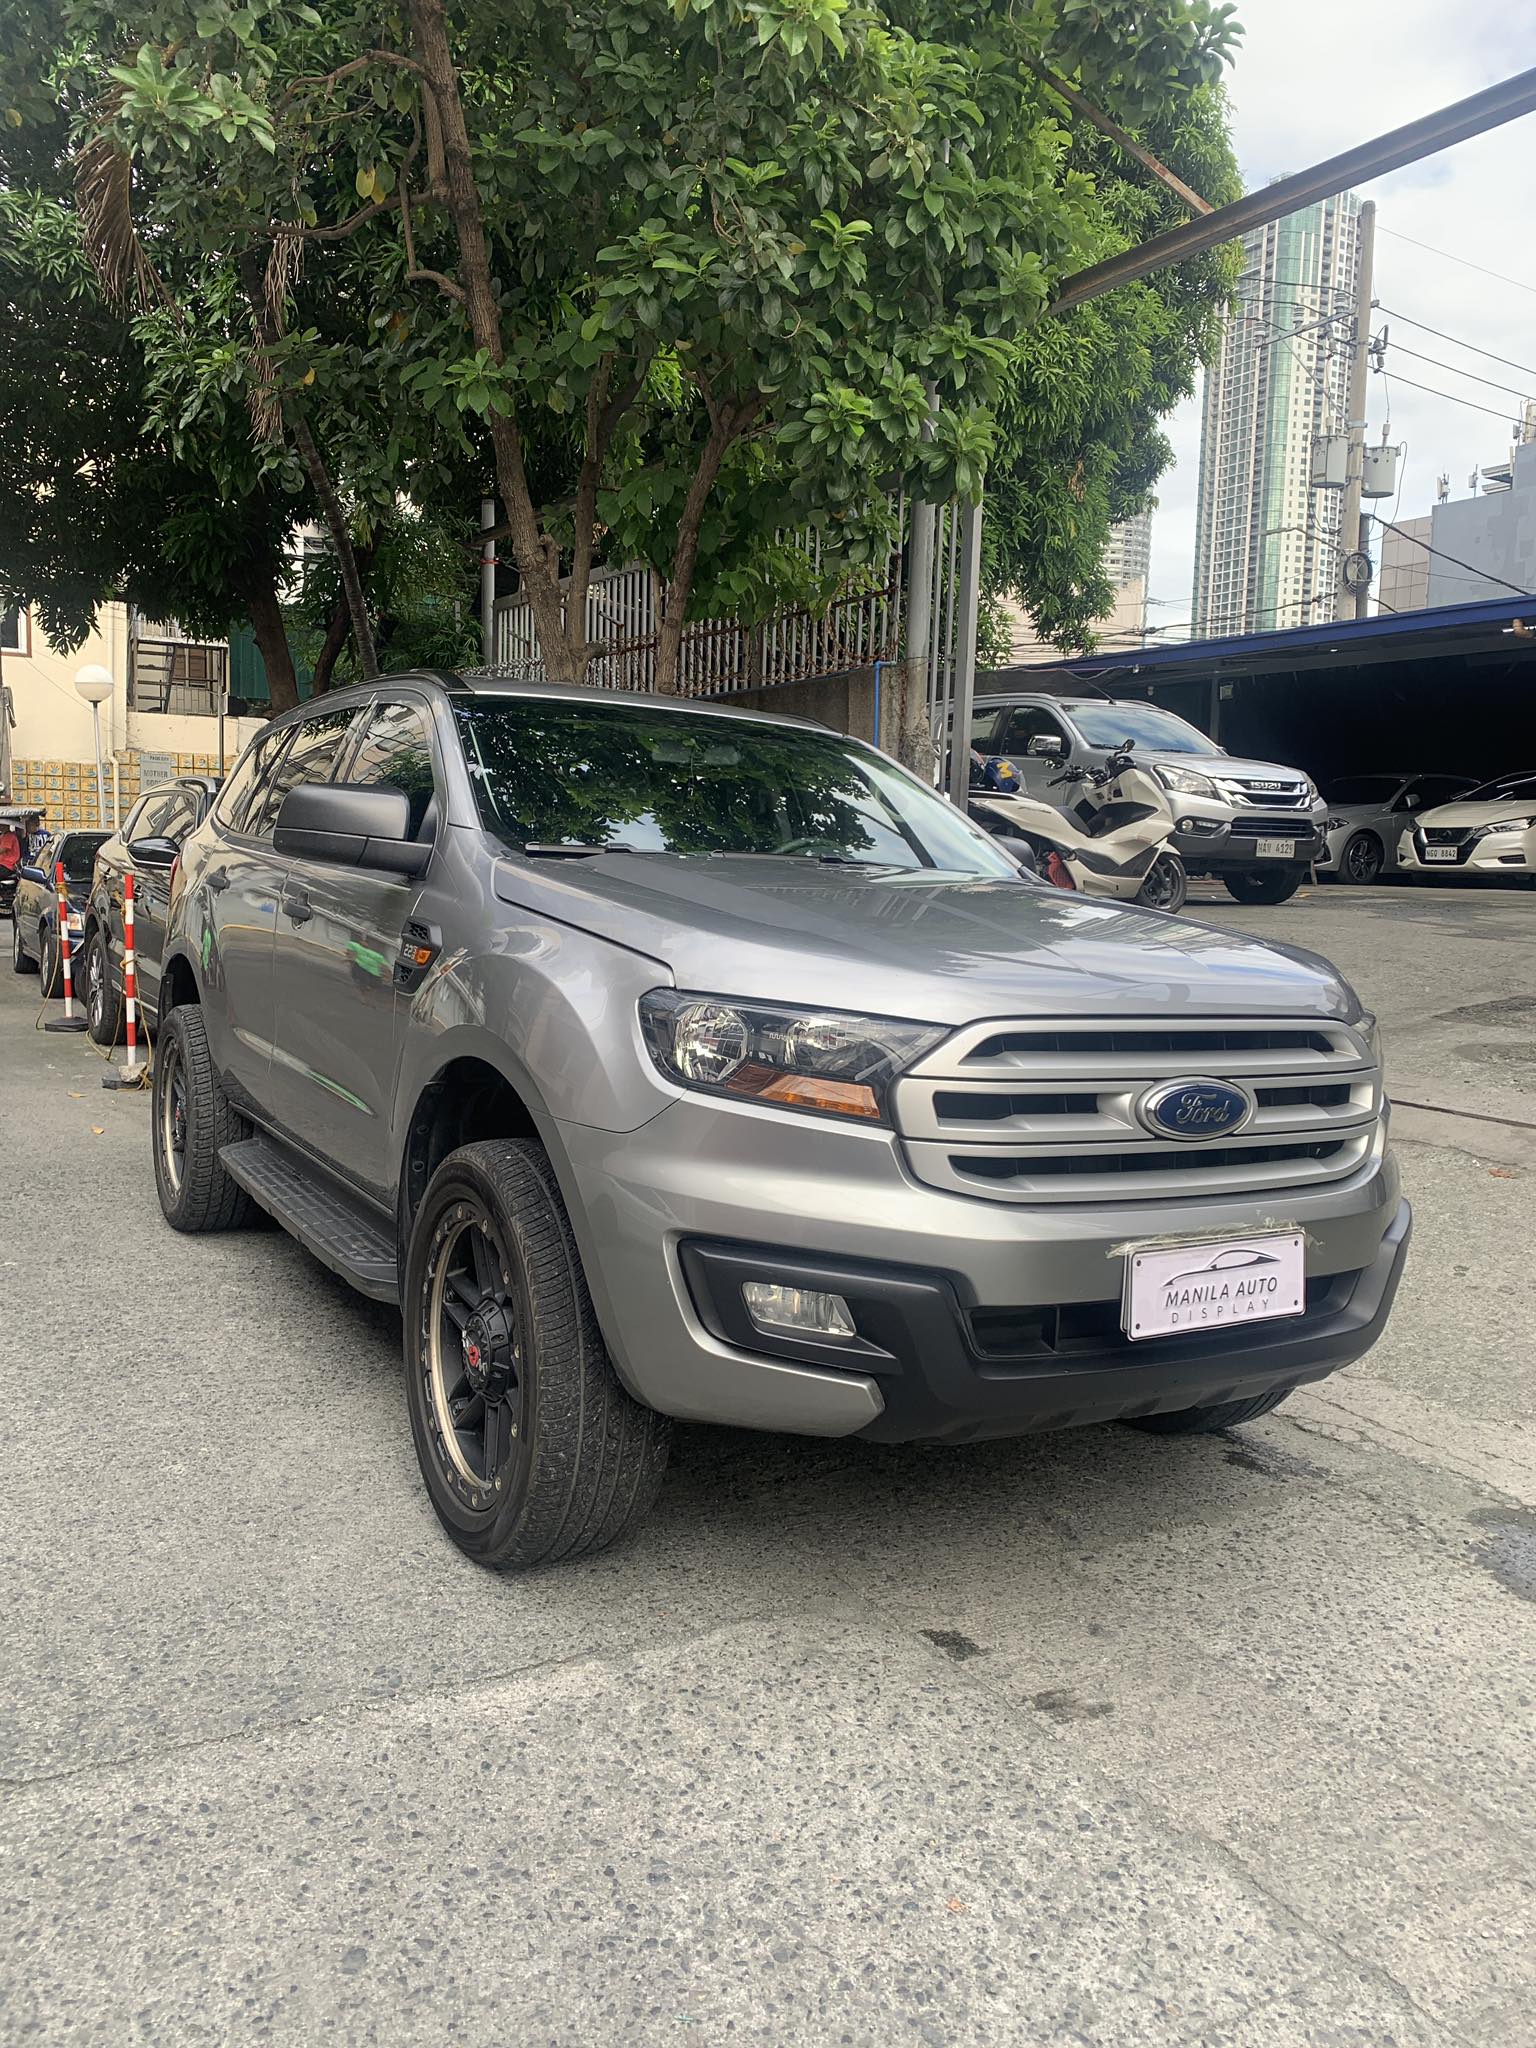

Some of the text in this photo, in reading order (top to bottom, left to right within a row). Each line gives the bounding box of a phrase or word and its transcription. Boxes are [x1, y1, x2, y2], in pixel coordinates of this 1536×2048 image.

[1249, 781, 1281, 790] ISUZU
[1176, 1092, 1231, 1124] Ford
[1165, 1276, 1279, 1309] MANILA AUTO
[1171, 1299, 1269, 1324] DISPLAY
